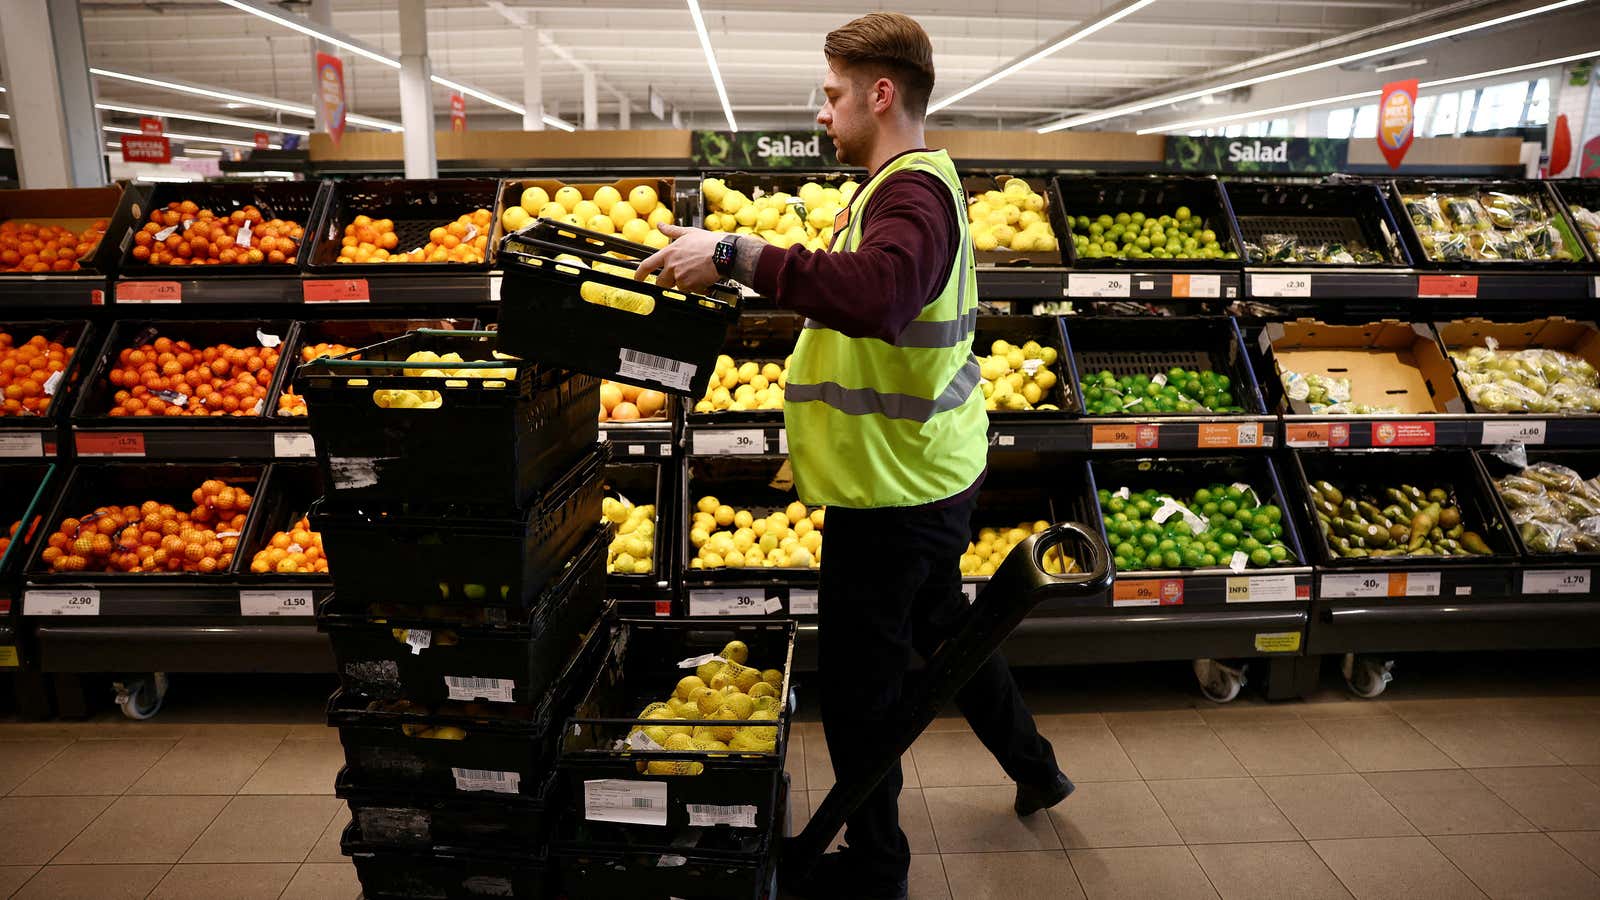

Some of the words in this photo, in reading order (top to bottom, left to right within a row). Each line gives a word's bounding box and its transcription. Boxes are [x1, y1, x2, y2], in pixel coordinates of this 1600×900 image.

[757, 135, 820, 157] Salad
[1229, 141, 1288, 162] Salad
[1108, 281, 1122, 289] 20p
[1286, 281, 1305, 289] £2.30
[737, 436, 754, 445] 30p
[1115, 432, 1129, 440] 99p
[1363, 579, 1380, 588] 40p
[1563, 575, 1584, 584] £1.70
[1137, 588, 1152, 597] 99p
[1228, 586, 1248, 594] INFO
[68, 597, 92, 605] £2.90
[283, 598, 306, 606] £1.50
[737, 596, 755, 606] 30p
